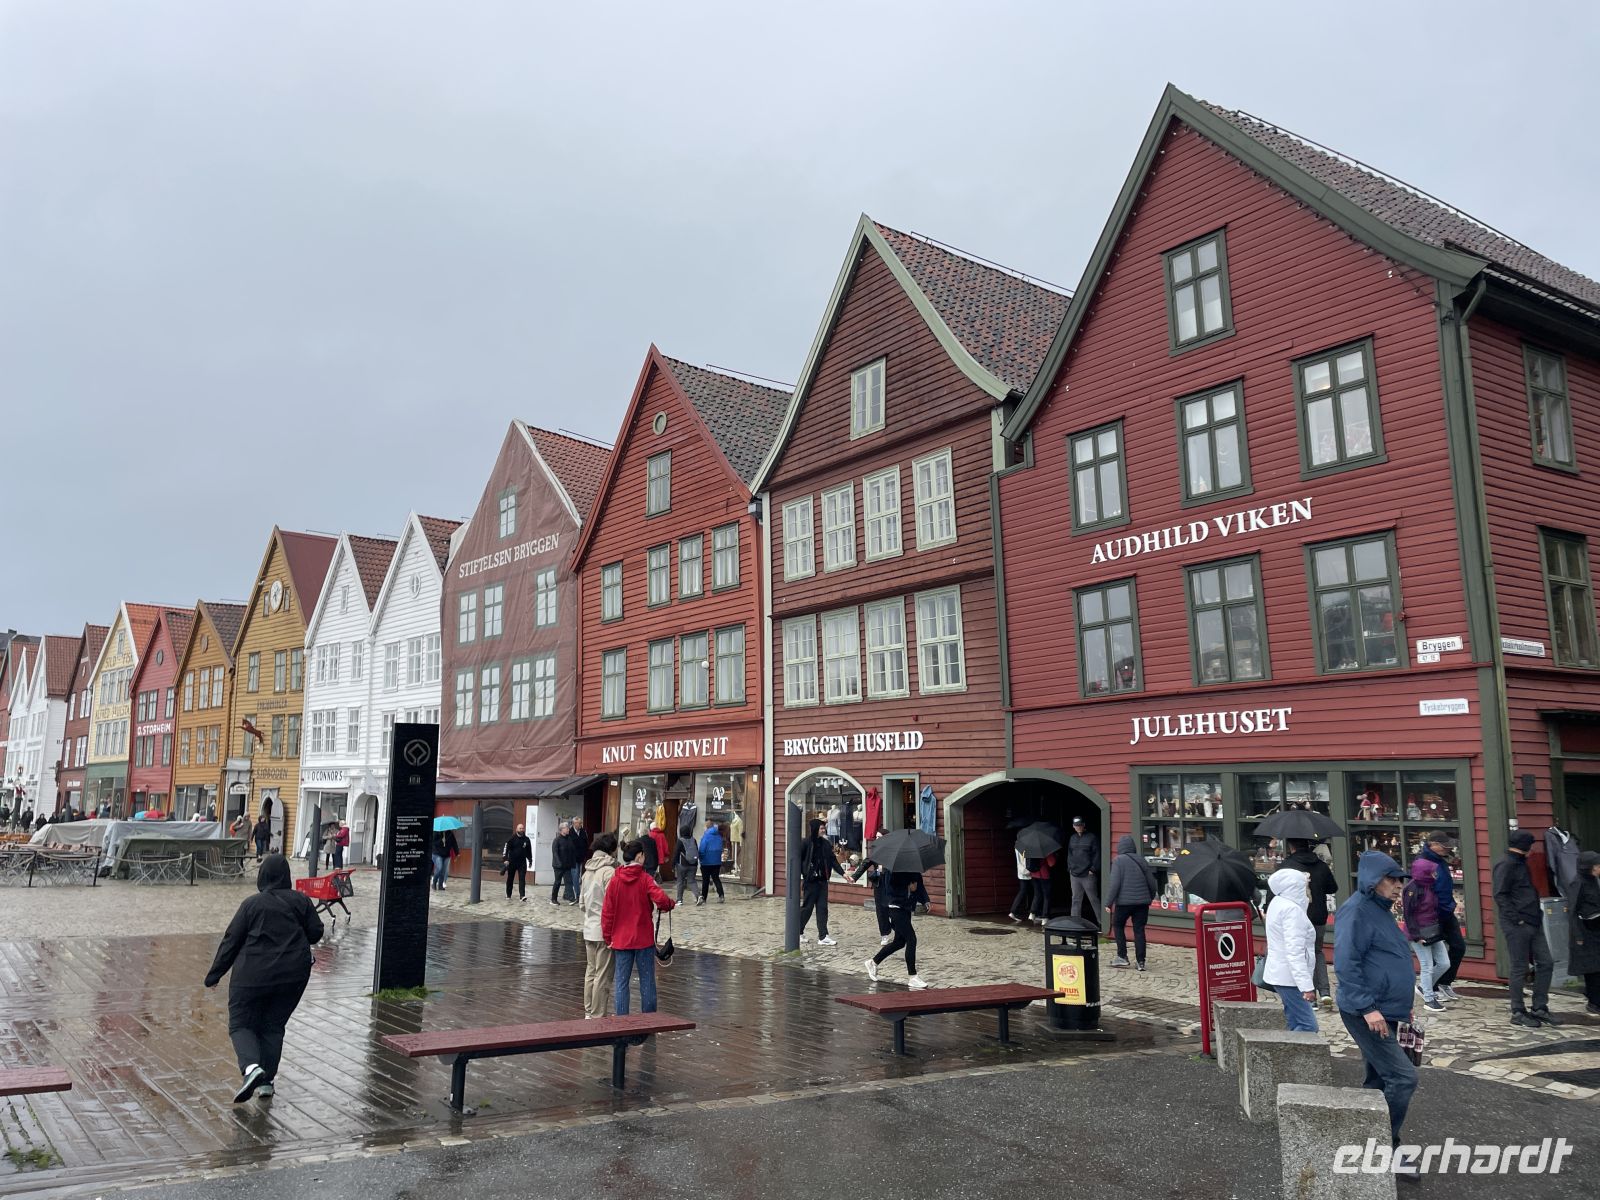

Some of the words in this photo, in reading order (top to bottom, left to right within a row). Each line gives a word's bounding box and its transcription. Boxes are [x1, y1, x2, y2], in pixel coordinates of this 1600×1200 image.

[1090, 521, 1209, 564] AUDHILD
[1213, 497, 1313, 537] VIKEN
[459, 548, 512, 578] STIFTELSEN
[514, 533, 560, 562] BRYGGEN
[1422, 640, 1456, 651] Bryggen
[1130, 707, 1292, 745] JULEHUSET
[602, 744, 637, 764] KNUT
[643, 736, 729, 760] SKURTVEIT
[783, 735, 848, 756] BRYGGEN
[853, 730, 924, 752] HUSFLID
